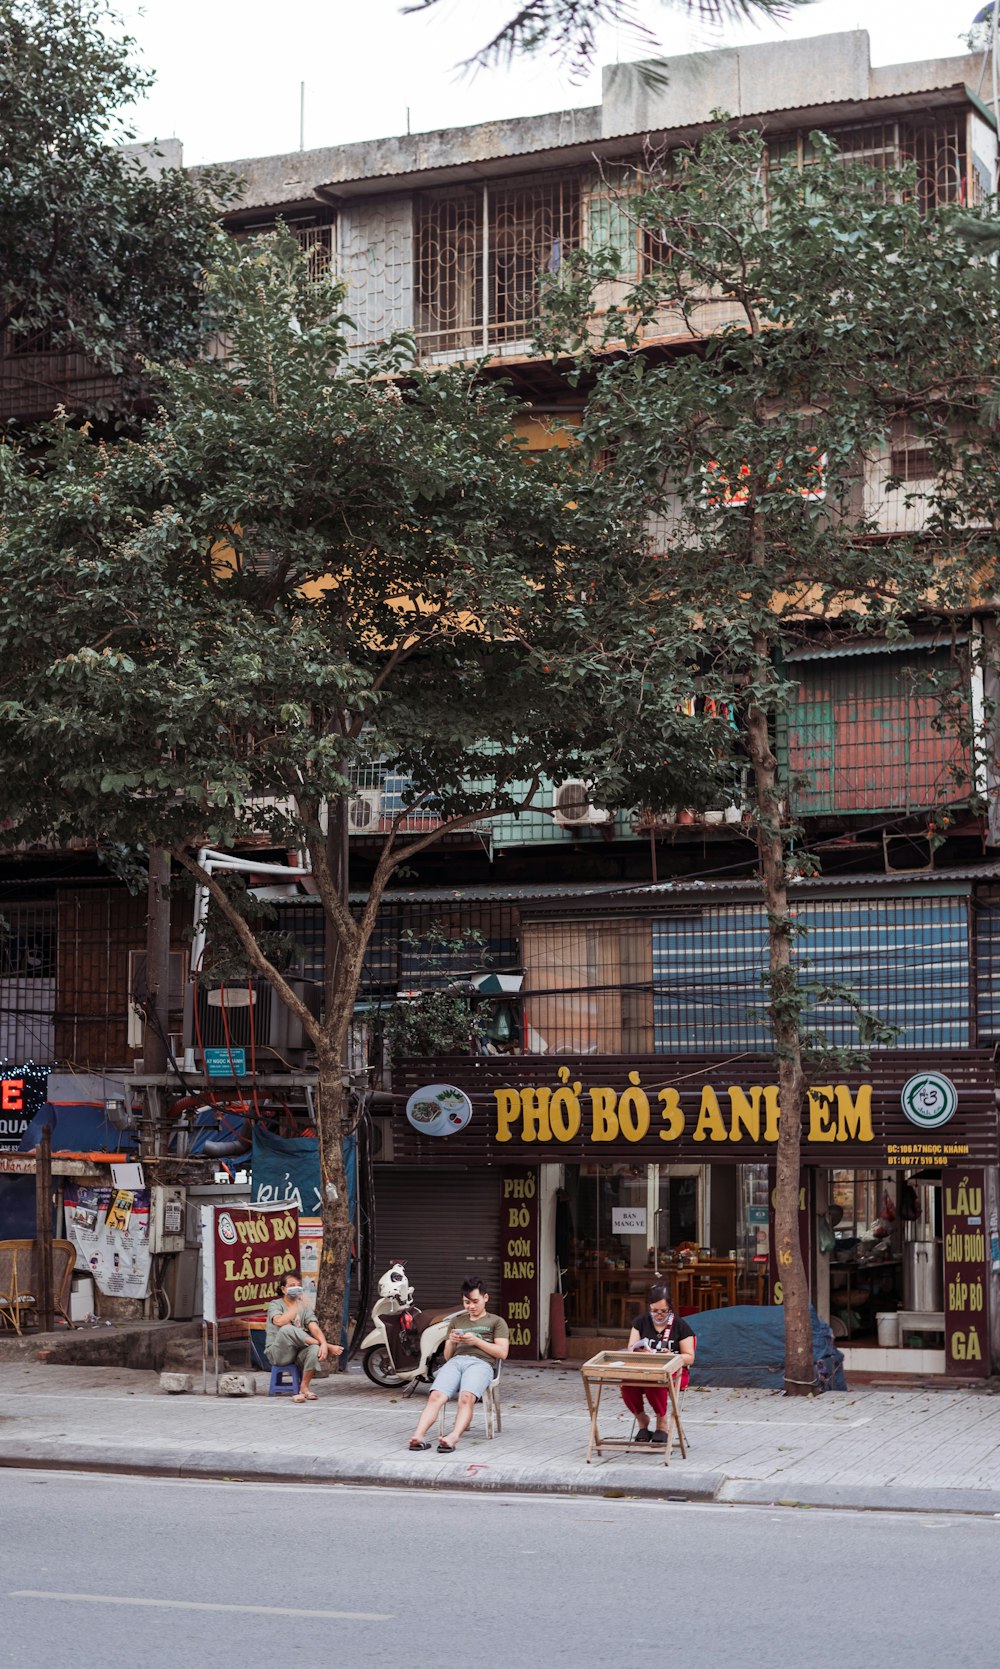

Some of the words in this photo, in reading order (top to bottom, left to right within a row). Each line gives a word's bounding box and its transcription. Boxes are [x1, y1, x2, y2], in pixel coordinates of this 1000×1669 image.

[493, 1066, 582, 1142] PHỞ
[589, 1070, 650, 1142] BÒ
[658, 1087, 685, 1141] 3
[806, 1084, 875, 1142] EM
[943, 1141, 969, 1154] KHÁNH
[504, 1171, 536, 1199] PHỞ
[946, 1176, 982, 1216] LẨU
[235, 1212, 270, 1244] PHỞ
[271, 1211, 297, 1241] BÒ
[508, 1203, 530, 1228] BÒ
[508, 1237, 531, 1257] CƠM
[779, 1249, 792, 1265] 16
[964, 1229, 985, 1263] ĐUÔI
[224, 1246, 270, 1281] LẨU
[273, 1249, 297, 1276] BÒ
[503, 1261, 535, 1280] RANG
[234, 1281, 259, 1302] CƠM
[949, 1272, 968, 1312] BẮP
[969, 1276, 983, 1312] BÒ
[508, 1295, 531, 1320] PHỞ
[508, 1323, 532, 1346] XÀO
[951, 1326, 982, 1361] GÀ
